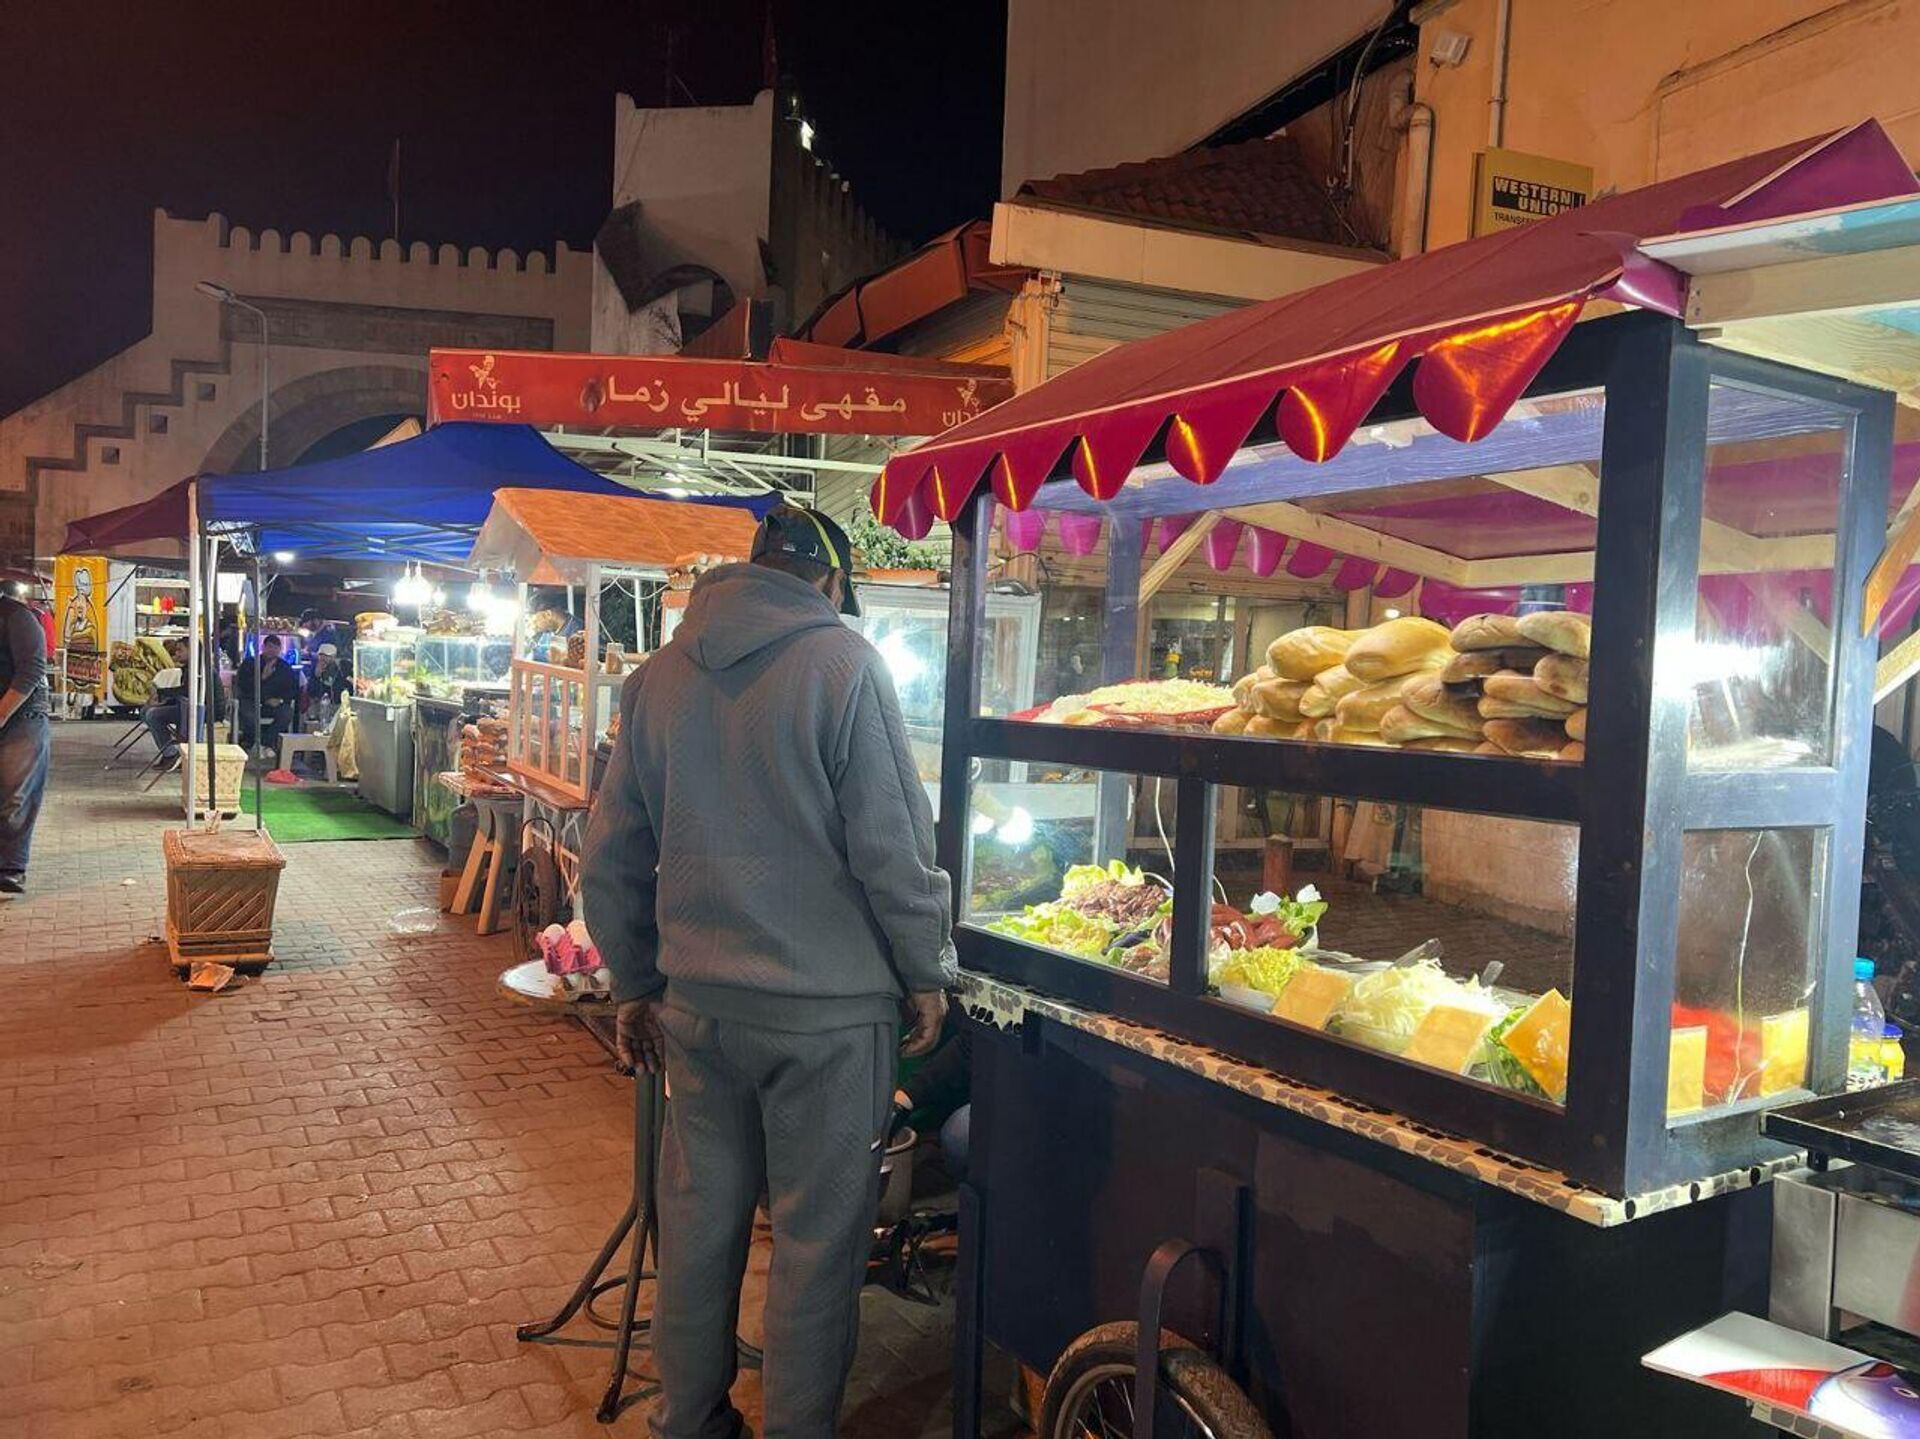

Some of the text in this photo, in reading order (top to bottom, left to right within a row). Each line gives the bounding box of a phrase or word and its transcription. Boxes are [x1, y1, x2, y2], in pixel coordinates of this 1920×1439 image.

[1494, 177, 1571, 206] WESTERN
[1518, 197, 1571, 217] UNION
[451, 388, 521, 414] بوندان
[681, 380, 789, 422] ليالي
[800, 387, 907, 422] مقهى
